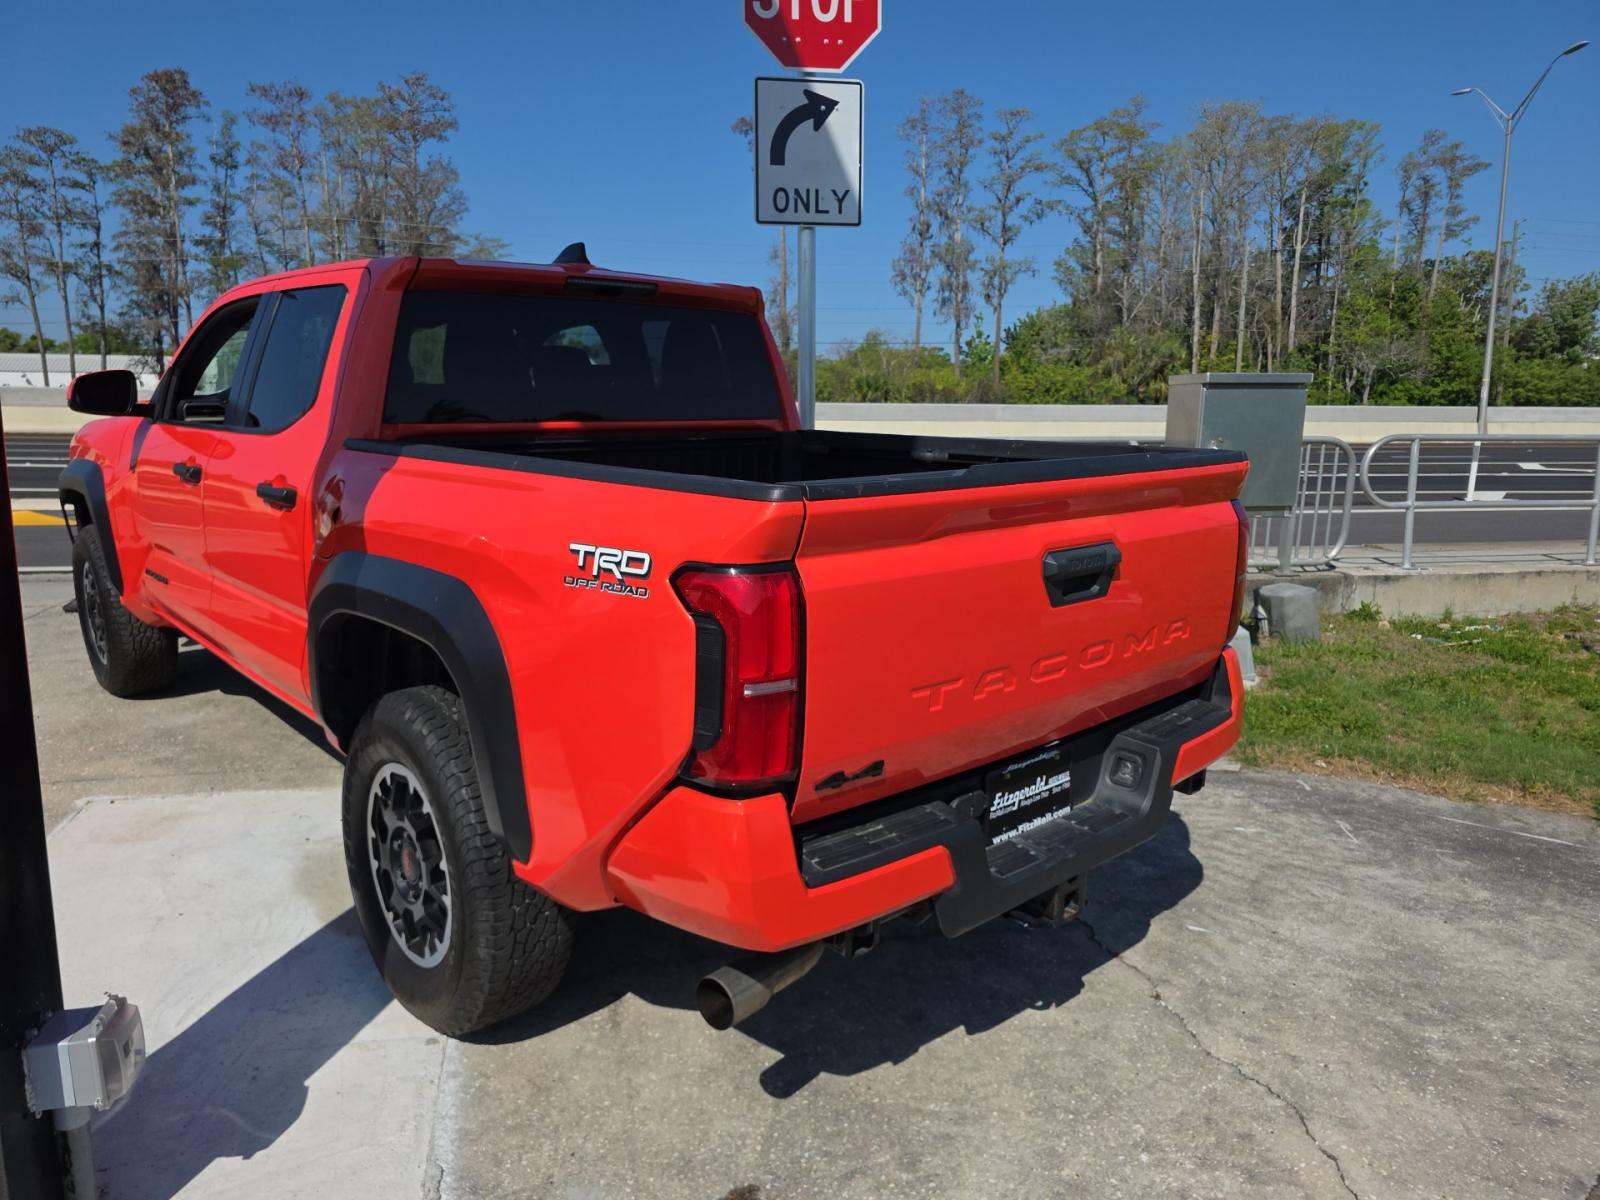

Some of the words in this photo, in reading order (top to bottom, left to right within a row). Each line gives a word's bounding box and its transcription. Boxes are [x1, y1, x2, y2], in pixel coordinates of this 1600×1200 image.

[772, 187, 850, 214] ONLY
[569, 543, 651, 580] TRD
[564, 576, 598, 589] OFF
[600, 581, 650, 599] ROAD
[910, 617, 1191, 712] TACOMA
